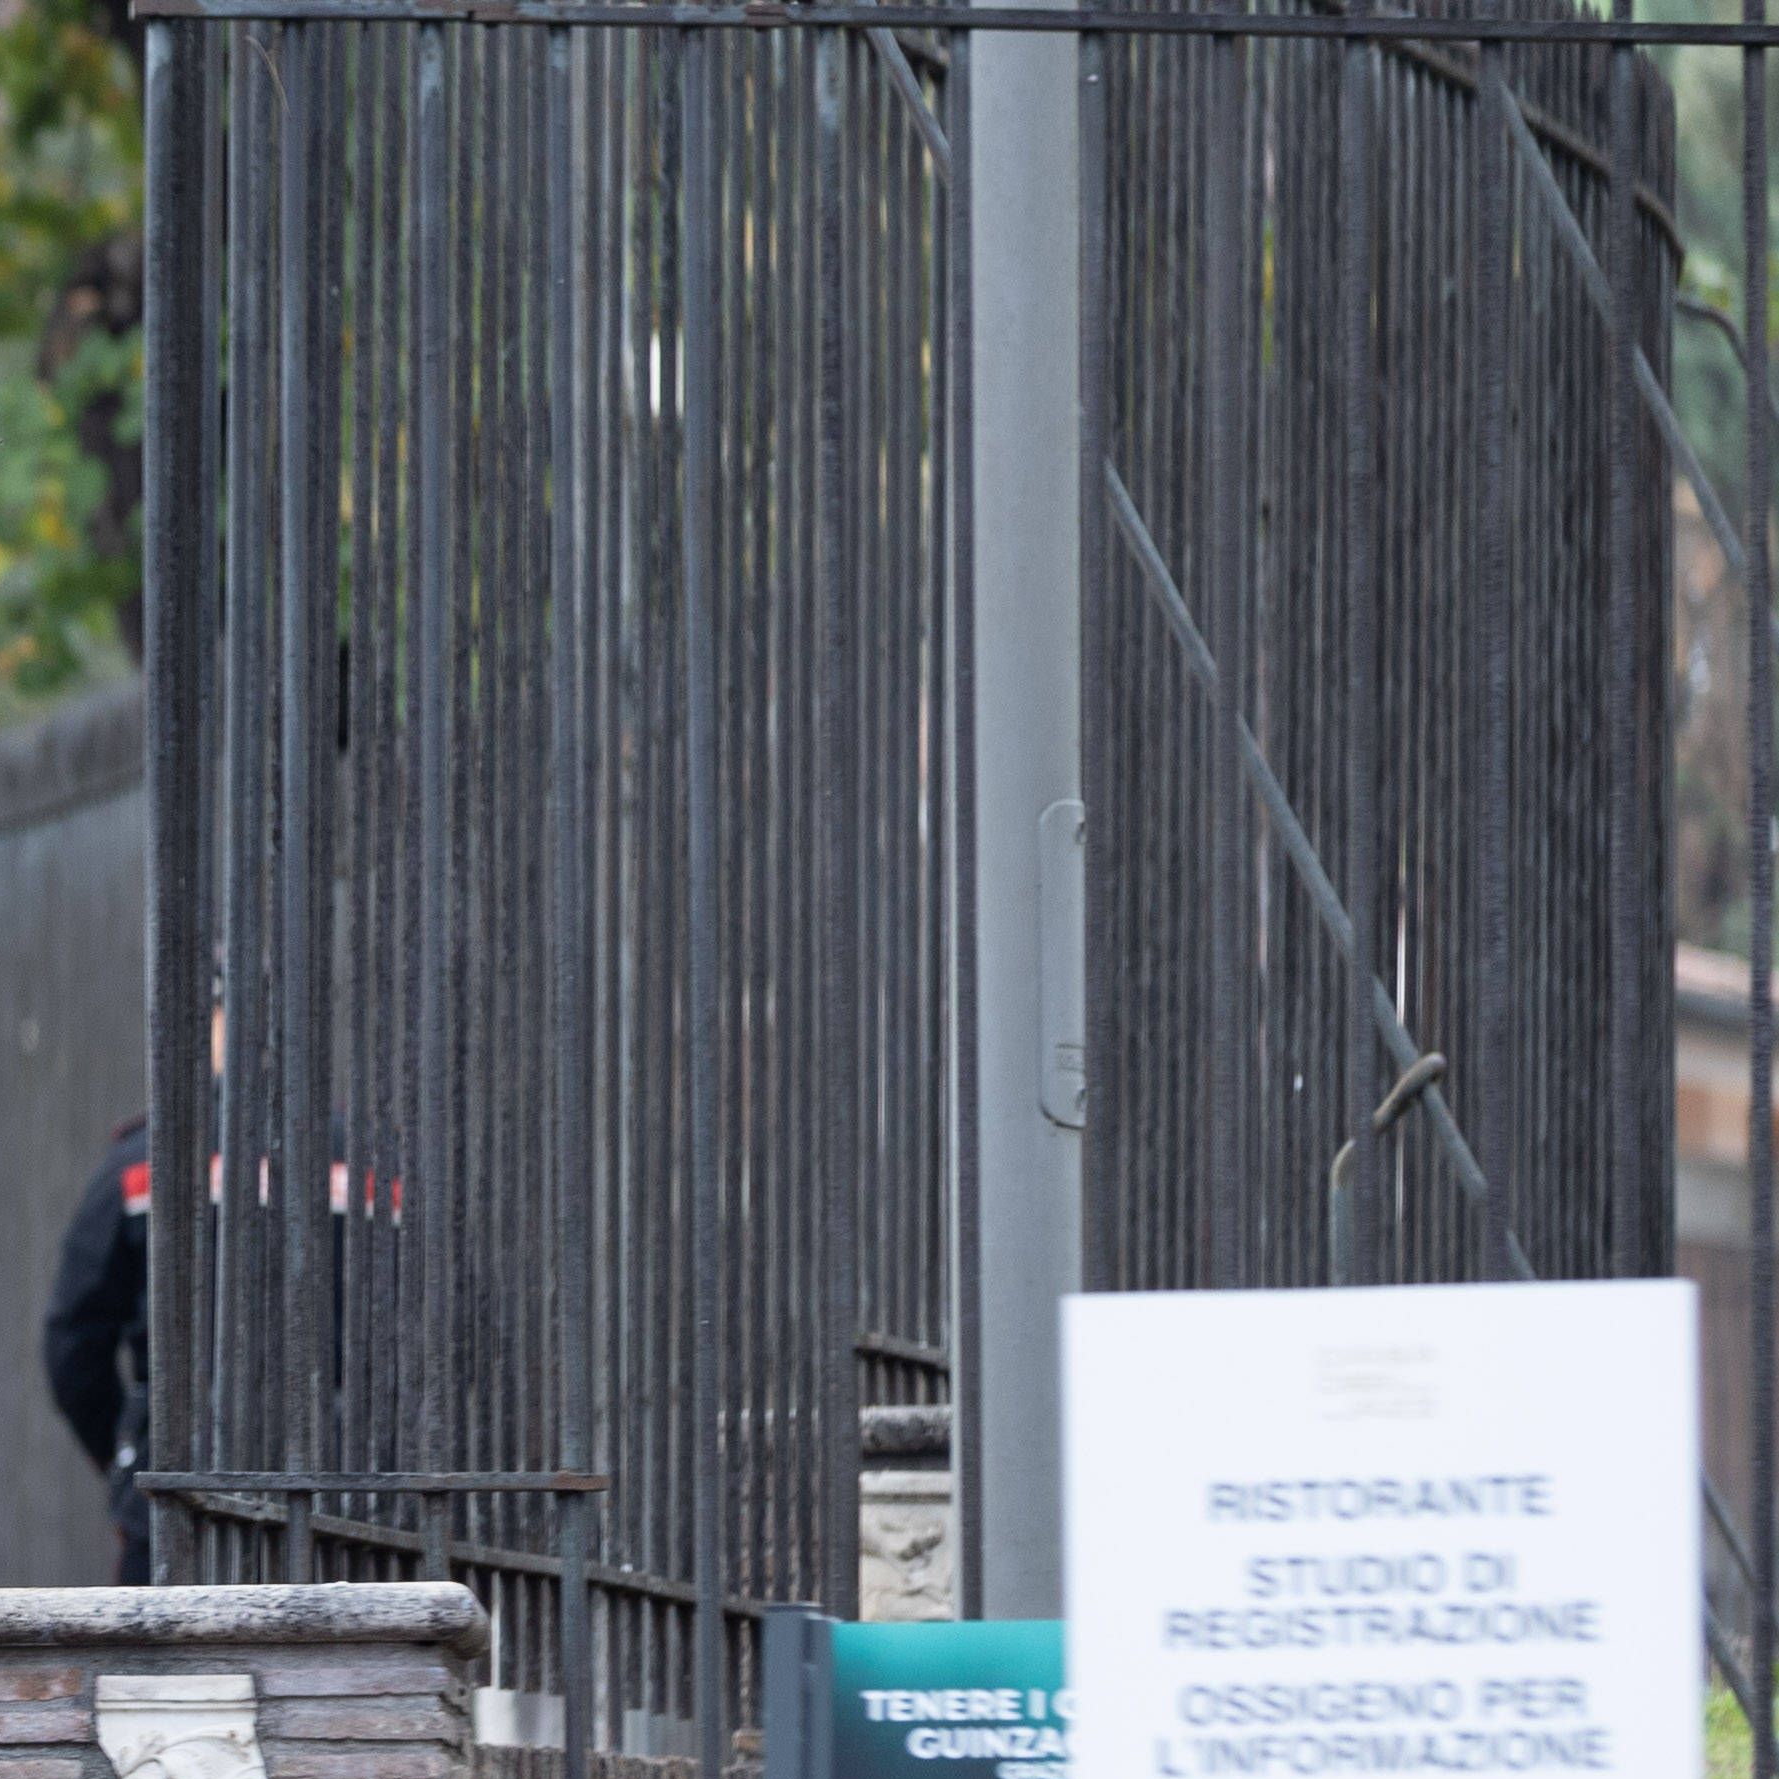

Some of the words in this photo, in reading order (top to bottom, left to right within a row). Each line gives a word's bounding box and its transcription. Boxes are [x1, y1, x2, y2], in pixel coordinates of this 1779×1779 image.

[1208, 1473, 1552, 1523] RISTORANTE
[1246, 1553, 1448, 1599] STUDIO
[1462, 1551, 1516, 1594] DI
[1164, 1601, 1601, 1651] REGISTRAZIONE
[859, 1688, 1022, 1722] TENERE
[1179, 1679, 1464, 1727] OSSIGENO
[1477, 1677, 1587, 1721] PER
[1156, 1727, 1613, 1779] L'INFORMAZIONE
